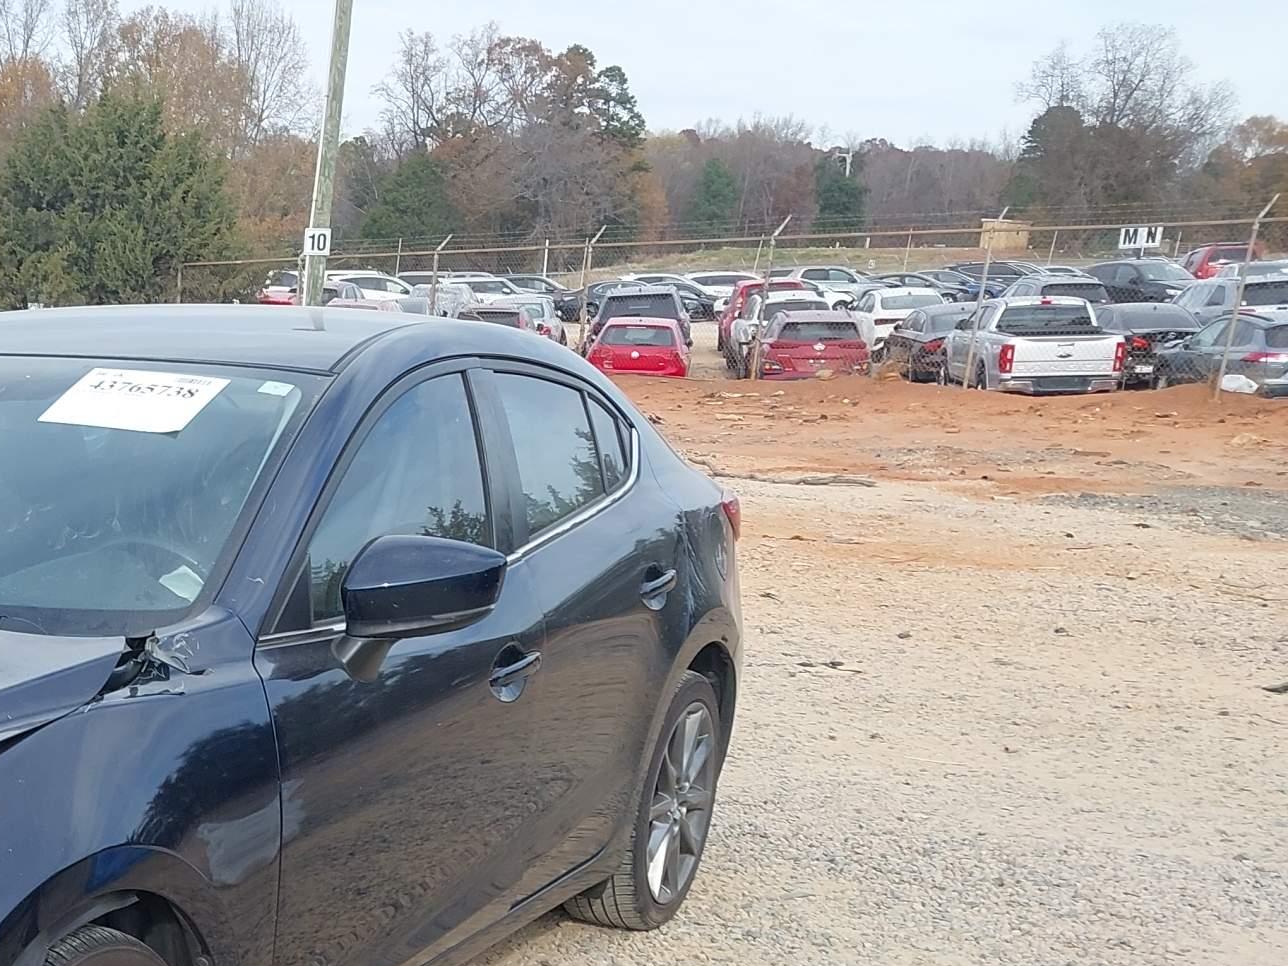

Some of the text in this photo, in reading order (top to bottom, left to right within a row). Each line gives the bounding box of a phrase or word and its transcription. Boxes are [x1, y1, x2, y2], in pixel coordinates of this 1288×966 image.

[308, 233, 327, 251] 10
[1123, 226, 1158, 245] M N
[89, 380, 200, 399] 43765738
